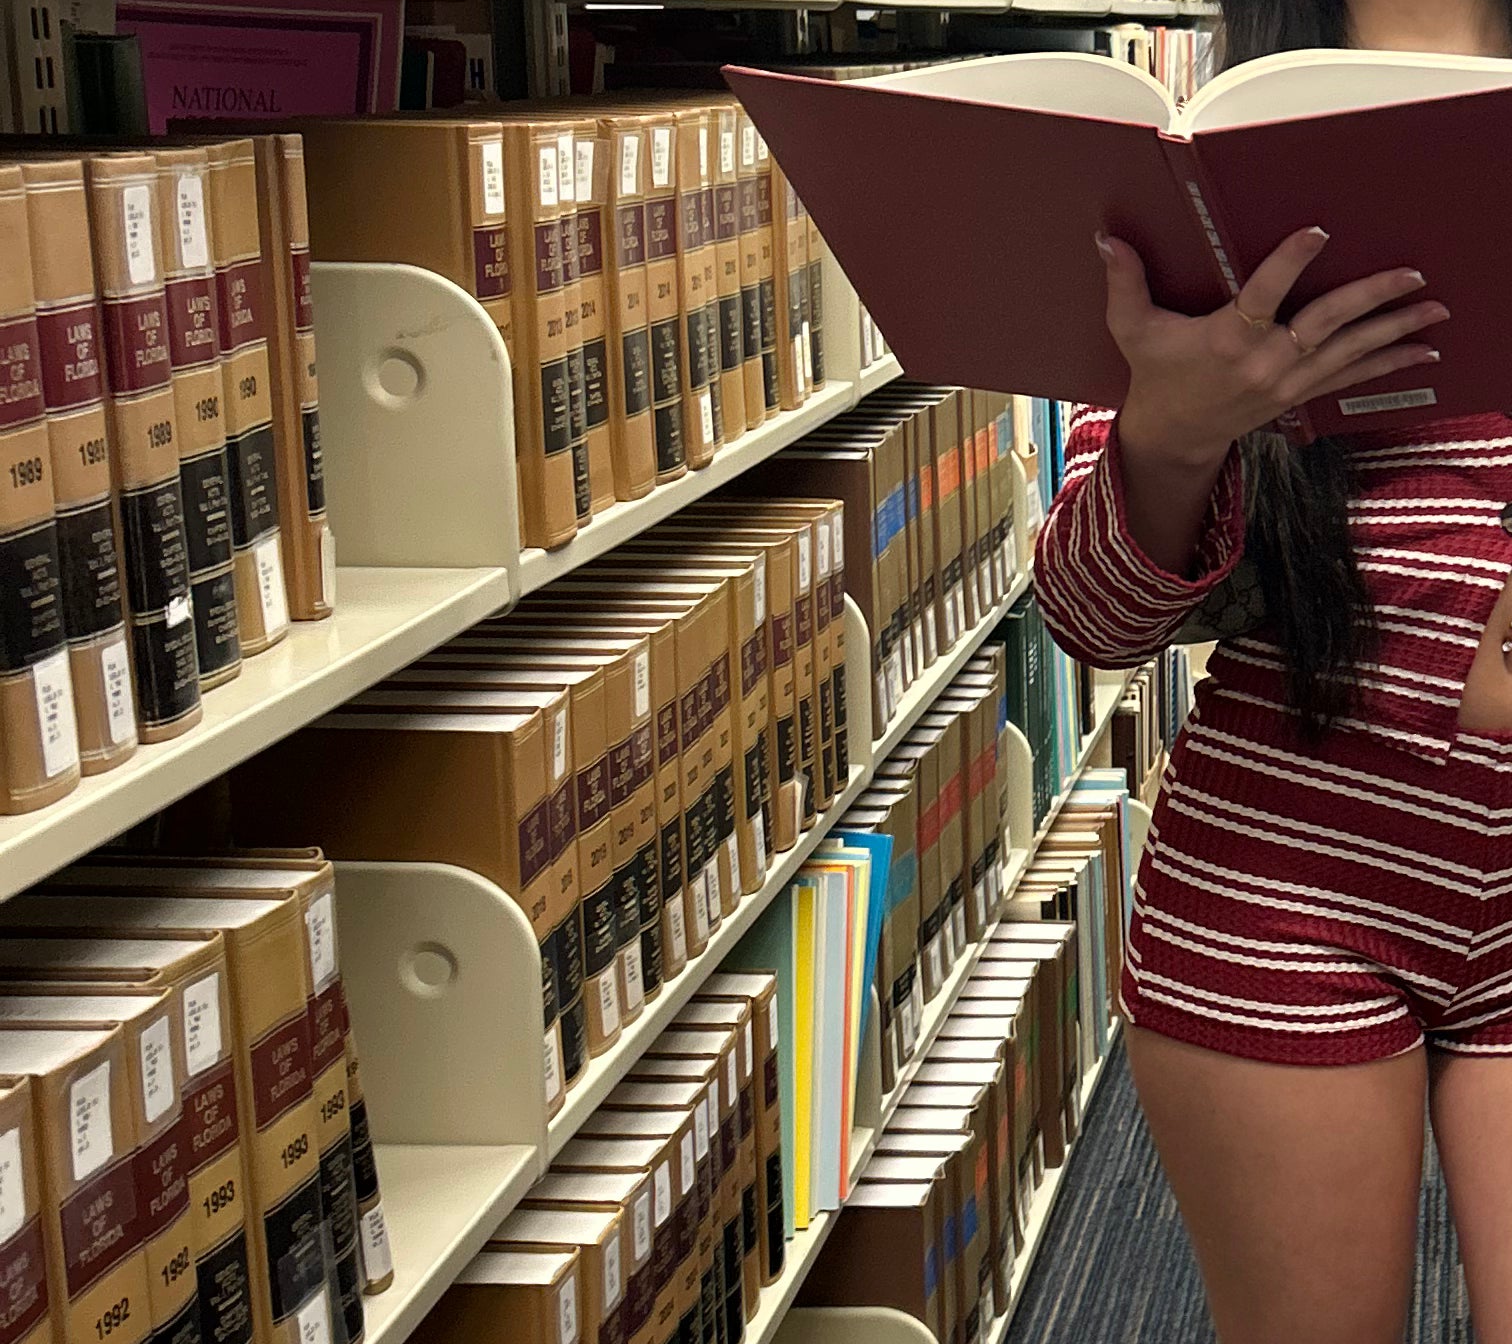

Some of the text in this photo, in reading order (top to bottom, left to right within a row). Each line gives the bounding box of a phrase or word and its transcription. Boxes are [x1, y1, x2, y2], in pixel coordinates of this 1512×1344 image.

[171, 85, 284, 114] NATIONAL
[230, 278, 247, 297] AWS
[187, 296, 211, 314] LAWS
[67, 323, 93, 344] LAWS
[137, 311, 161, 331] LAWS
[193, 313, 206, 329] OF
[76, 343, 89, 360] OF
[145, 330, 157, 346] OF
[9, 363, 26, 382] OF
[64, 359, 99, 383] FLORIDA
[148, 421, 172, 449] 1989
[9, 458, 42, 489] 1989
[271, 1037, 299, 1066] LAWS
[278, 1057, 293, 1078] OF
[194, 1084, 225, 1114] LAWS
[270, 1069, 308, 1103] FLORIDA
[204, 1105, 219, 1127] OF
[320, 1090, 345, 1124] 1993
[193, 1115, 232, 1154] FLORIDA
[153, 1143, 178, 1175] LAWS
[281, 1133, 309, 1169] 1993
[160, 1166, 174, 1189] OF
[82, 1191, 113, 1224] LAWS
[150, 1177, 187, 1217] FLORIDA
[203, 1181, 235, 1219] 1993
[92, 1214, 107, 1237] OF
[79, 1224, 125, 1267] FLORIDA
[161, 1247, 190, 1287] 1992
[95, 1298, 130, 1341] 1992
